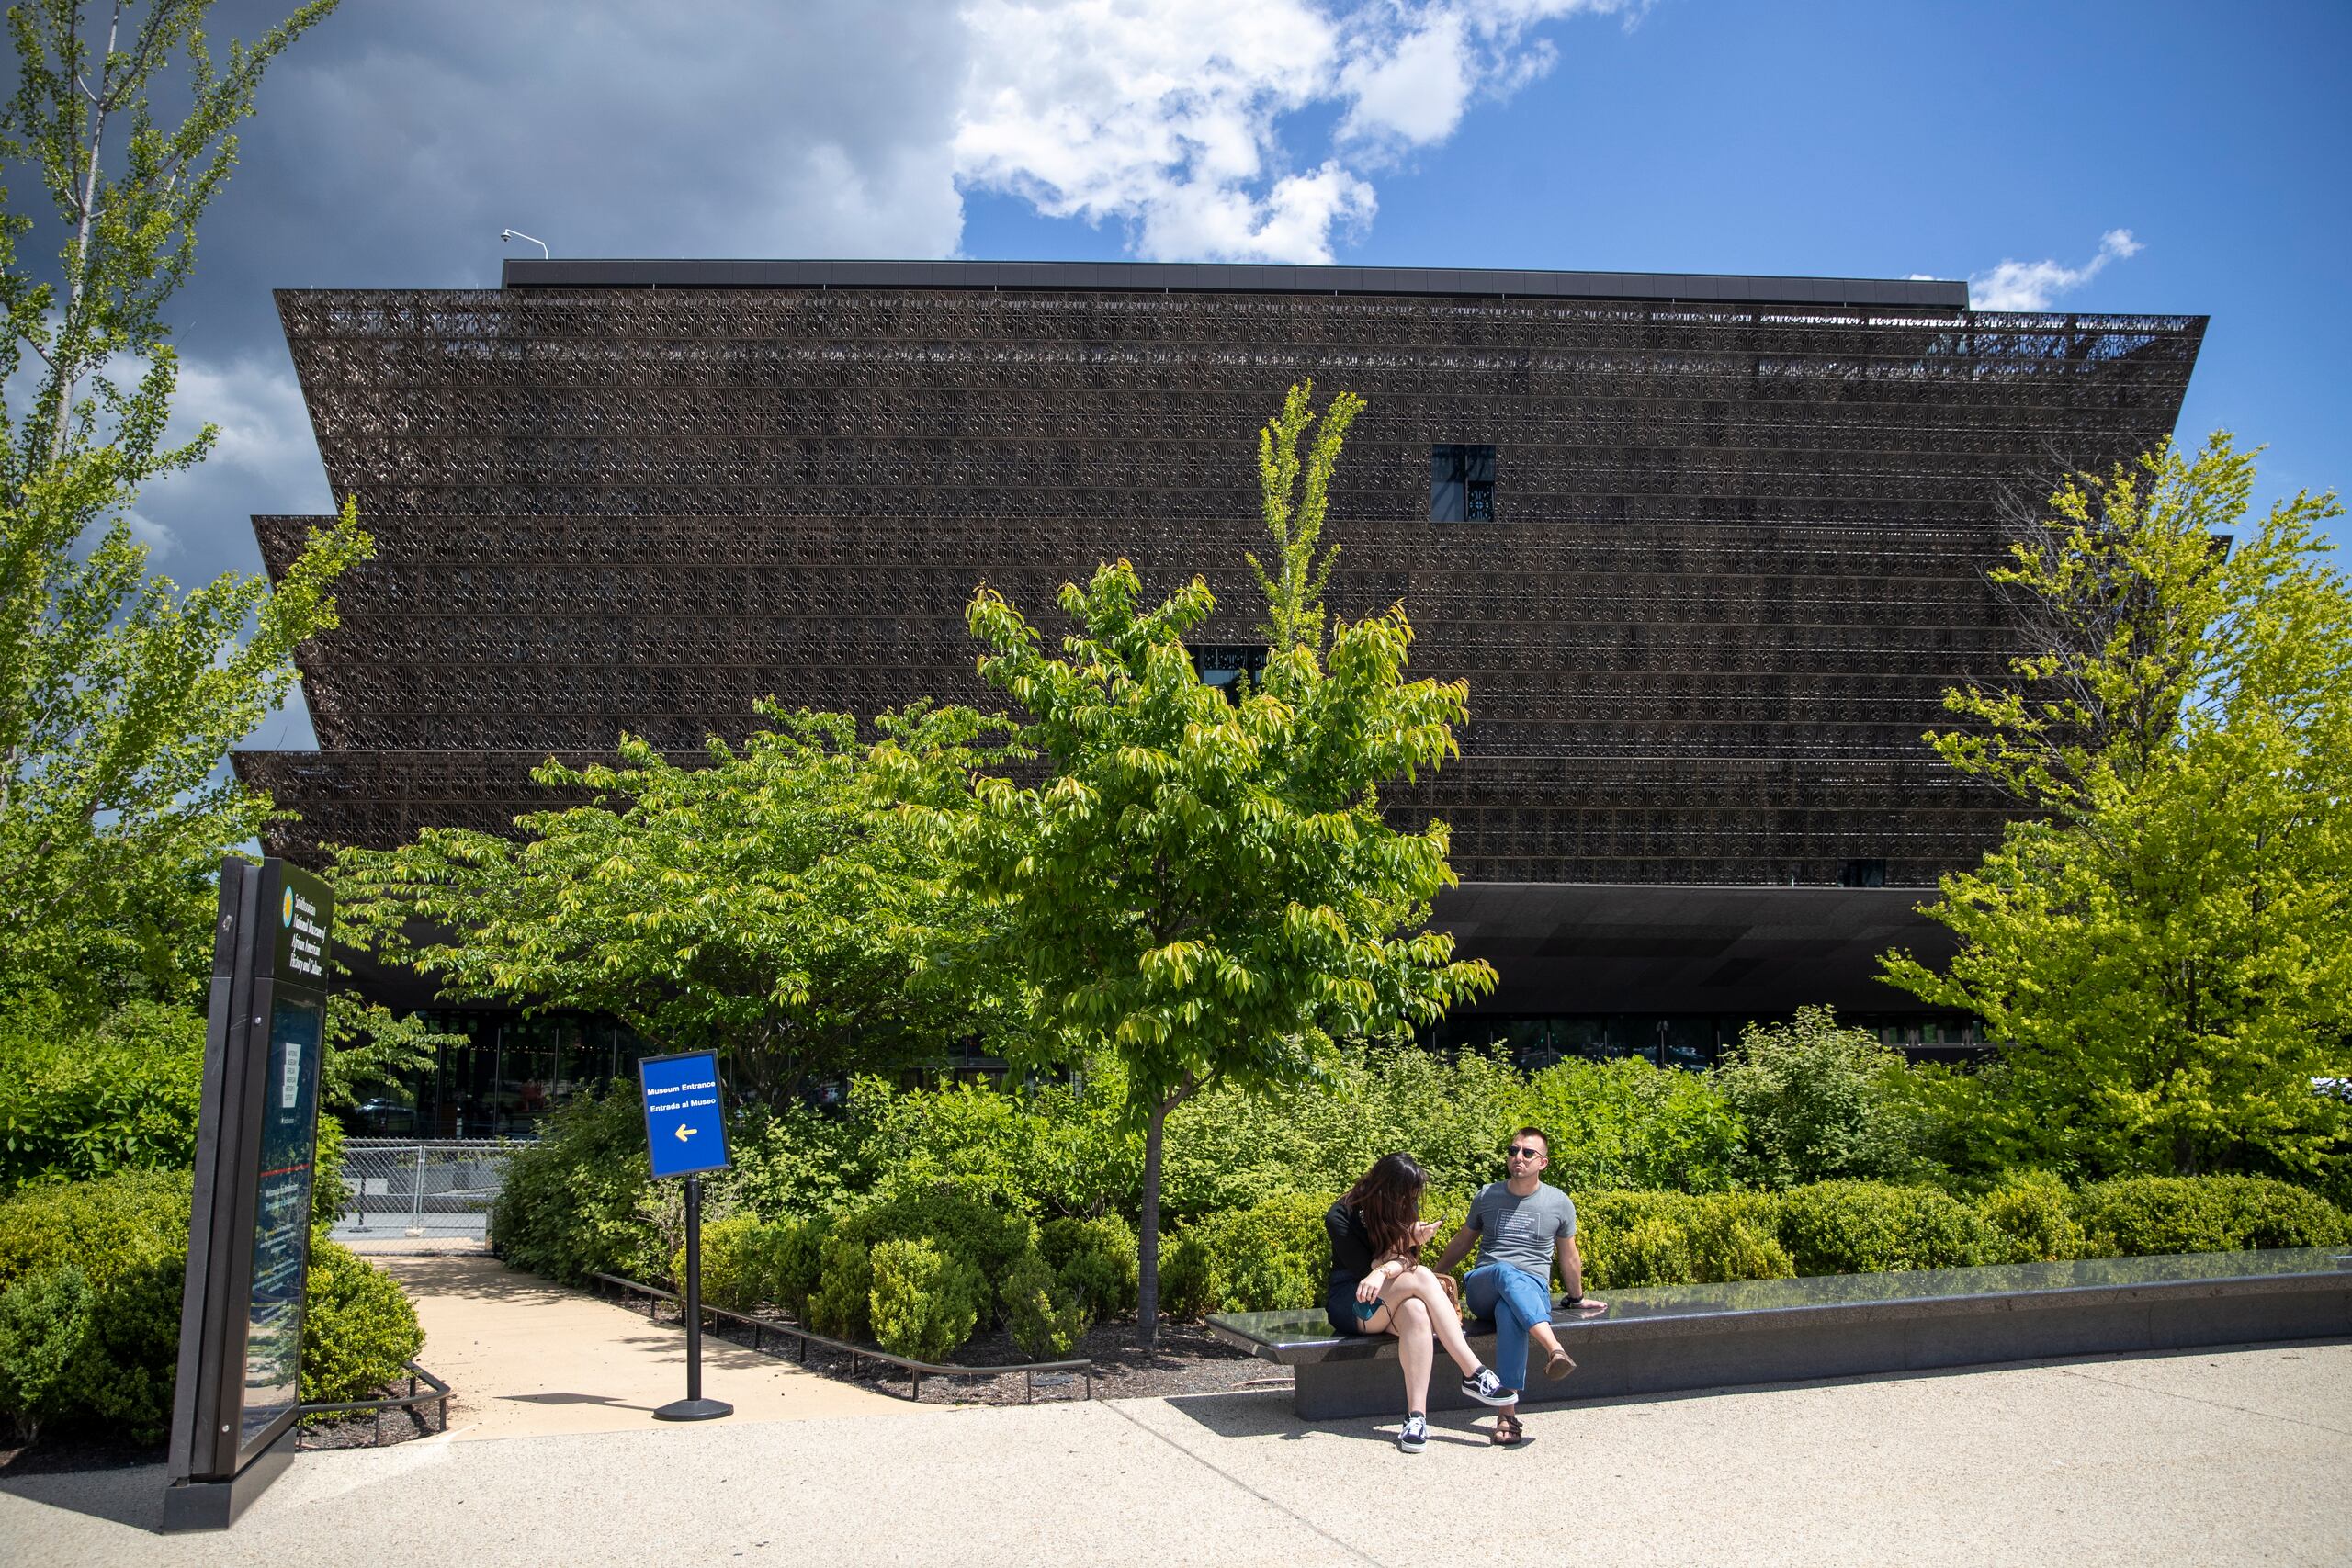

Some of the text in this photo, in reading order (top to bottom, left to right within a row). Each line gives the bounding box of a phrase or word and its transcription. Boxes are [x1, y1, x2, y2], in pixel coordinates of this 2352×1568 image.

[647, 1081, 716, 1096] Museum Entrance
[650, 1103, 680, 1113] Entrada
[691, 1098, 716, 1107] Museo
